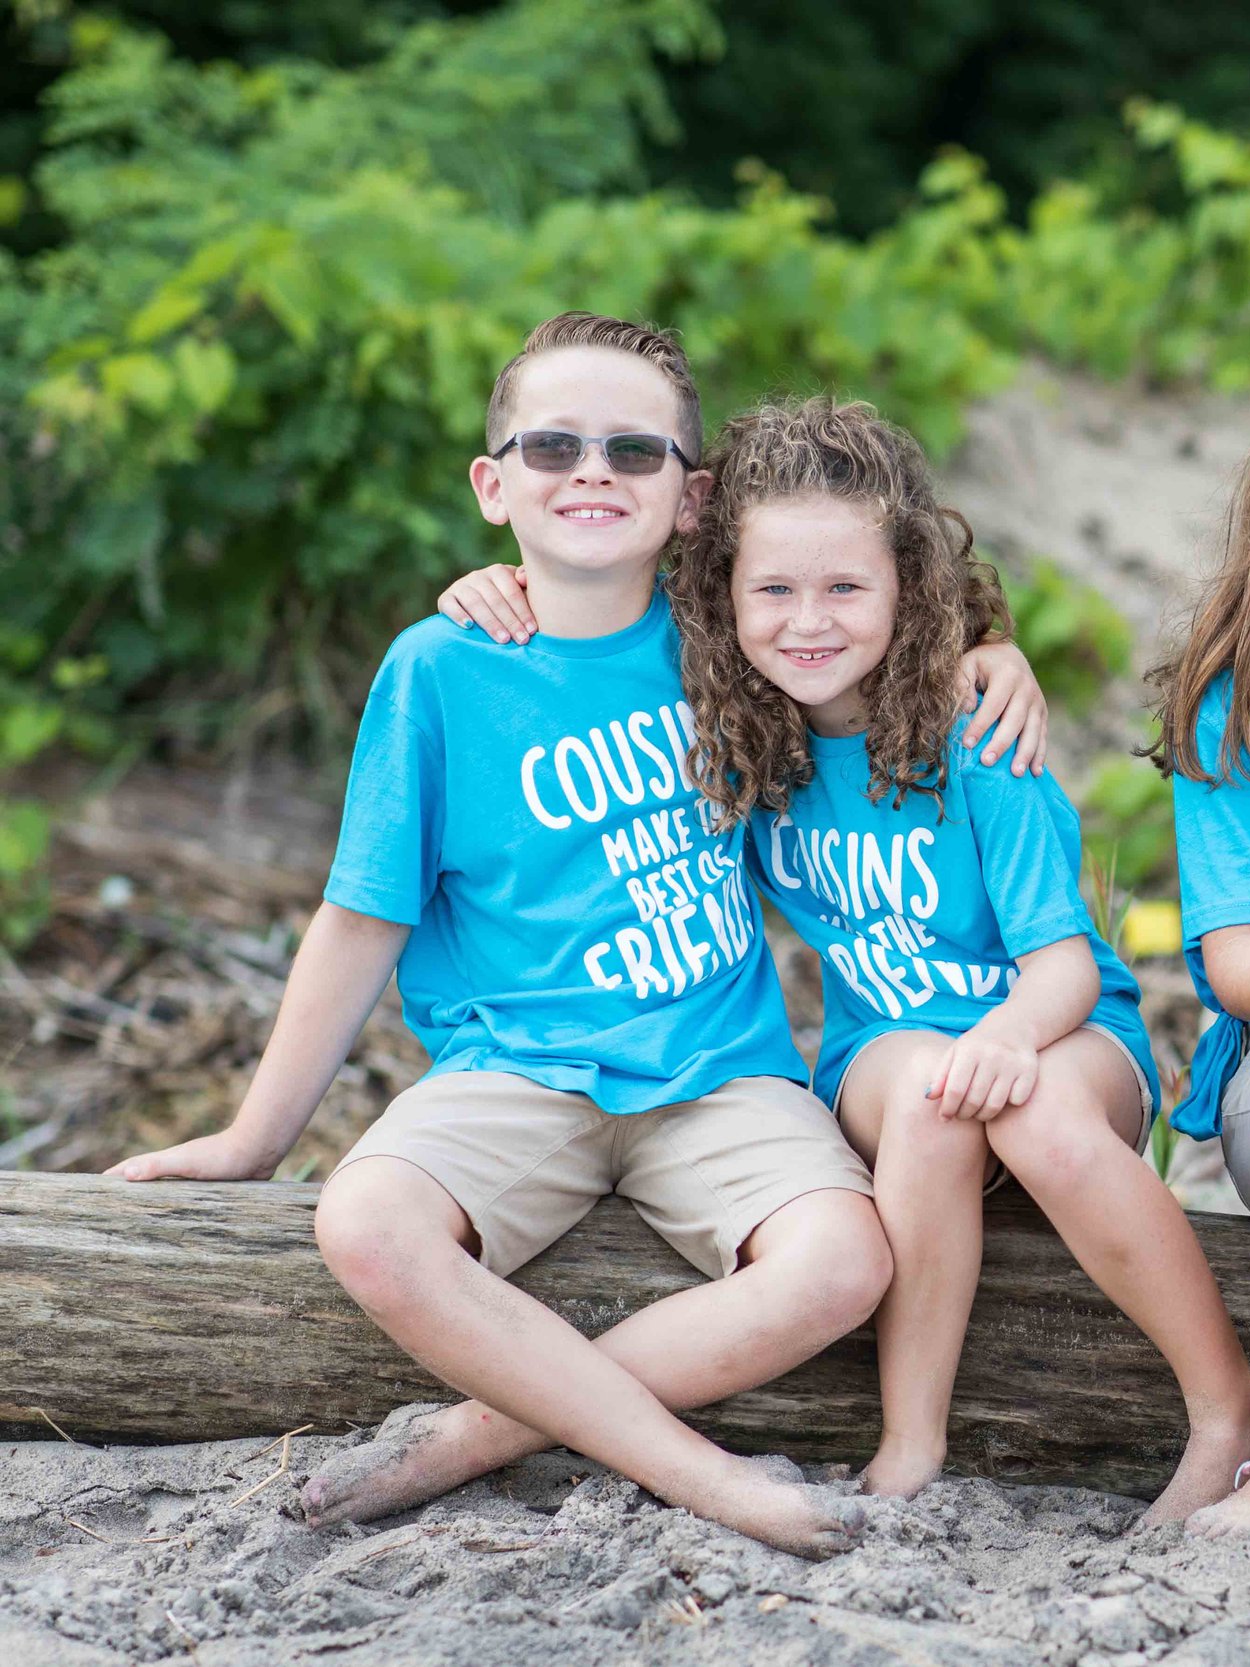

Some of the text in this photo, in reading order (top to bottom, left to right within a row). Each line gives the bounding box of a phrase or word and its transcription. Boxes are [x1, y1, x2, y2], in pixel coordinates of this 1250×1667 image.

[521, 700, 705, 829] COUSI
[601, 808, 694, 877] MAKE
[626, 843, 735, 922] BEST OF
